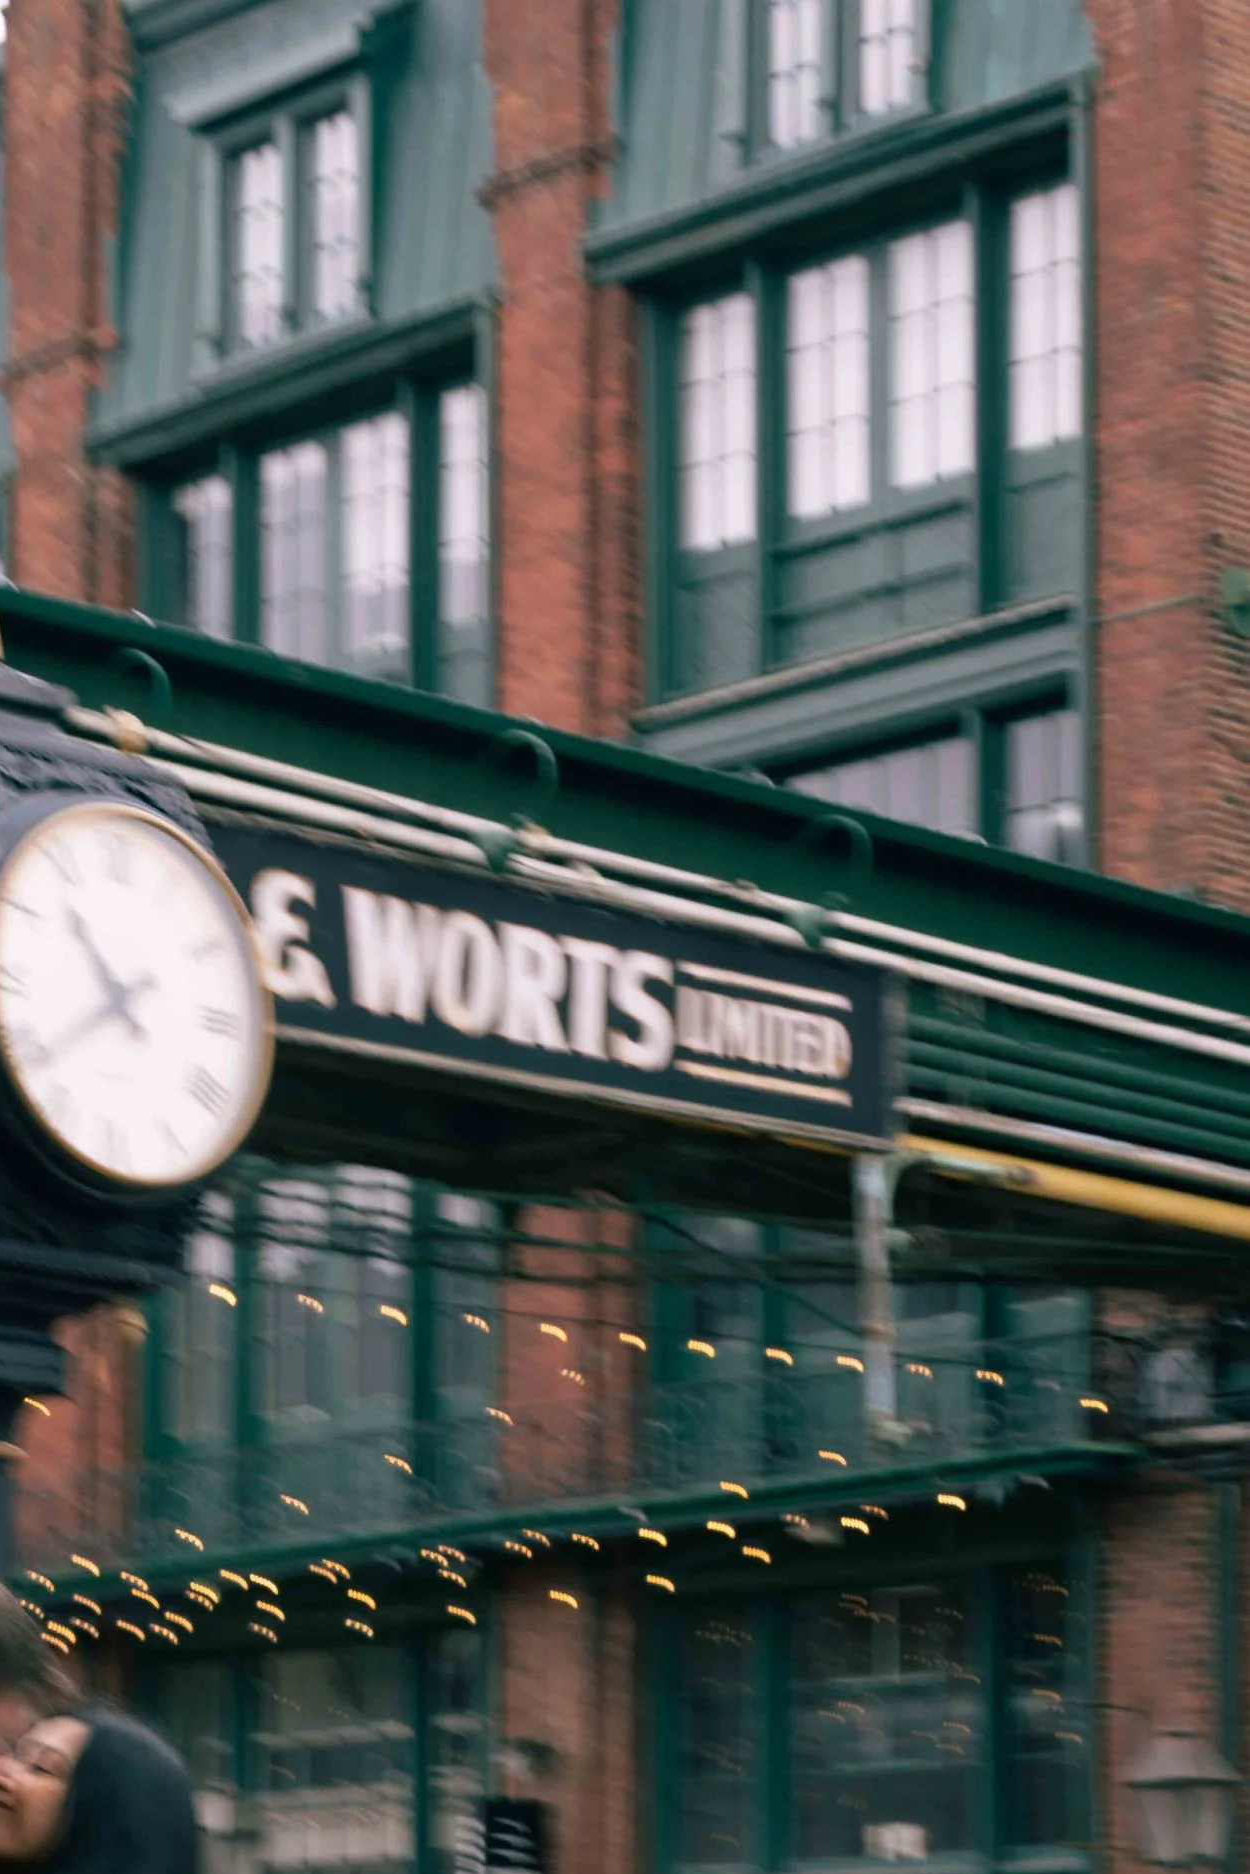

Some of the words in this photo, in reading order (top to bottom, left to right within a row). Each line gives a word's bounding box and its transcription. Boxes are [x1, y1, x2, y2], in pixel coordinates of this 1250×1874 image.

[251, 866, 337, 1009] &
[340, 884, 674, 1073] WORTS
[675, 984, 853, 1080] LIMITED
